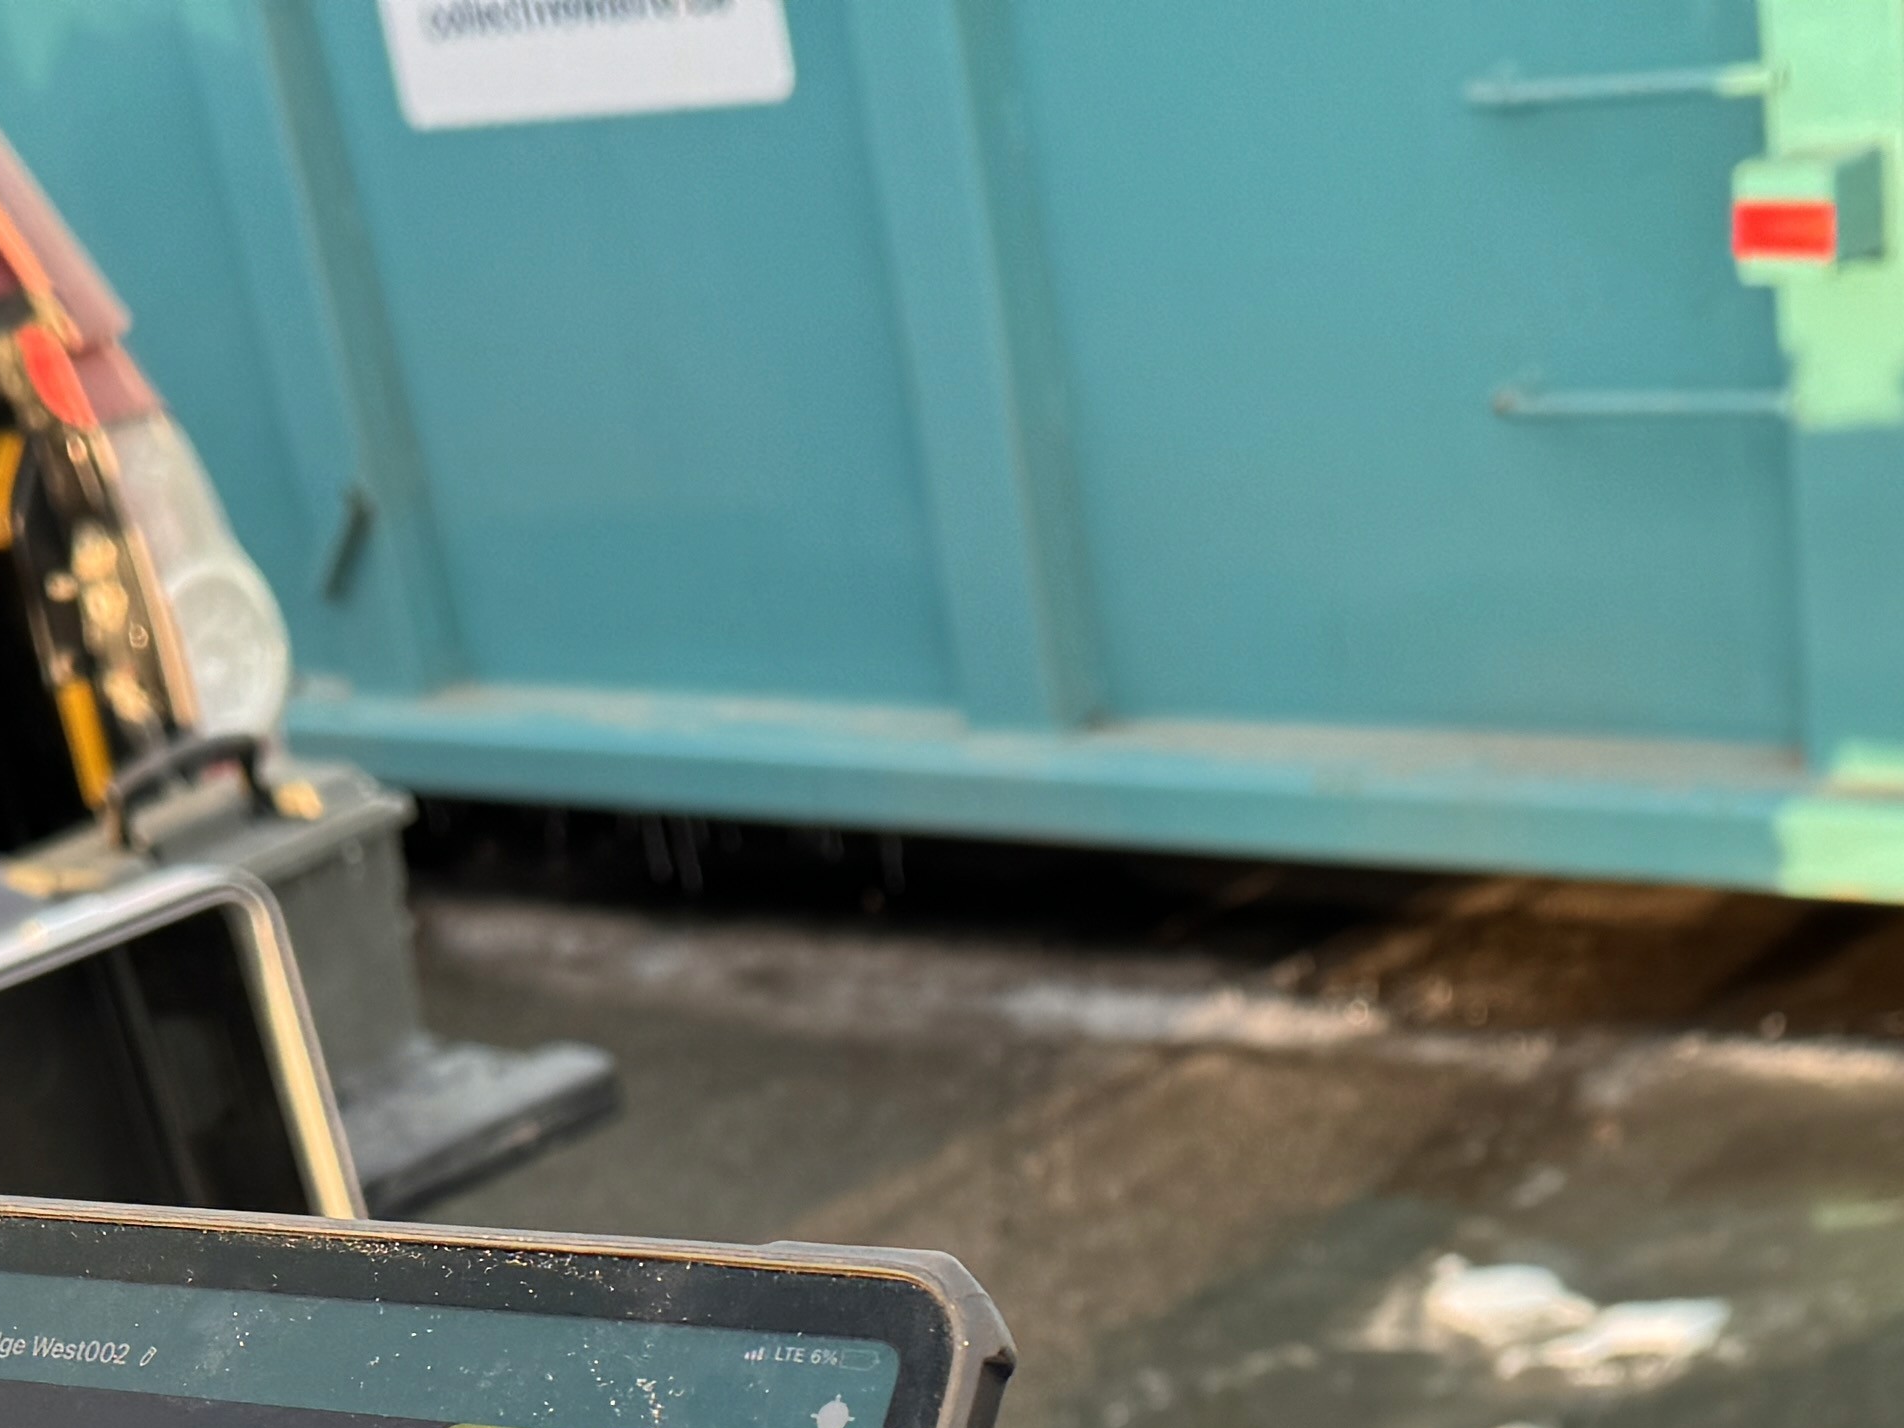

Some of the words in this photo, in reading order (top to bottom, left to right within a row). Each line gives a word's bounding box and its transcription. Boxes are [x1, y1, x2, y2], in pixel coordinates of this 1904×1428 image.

[31, 1334, 131, 1366] West002
[774, 1346, 806, 1364] LTE
[809, 1348, 838, 1366] 6%
